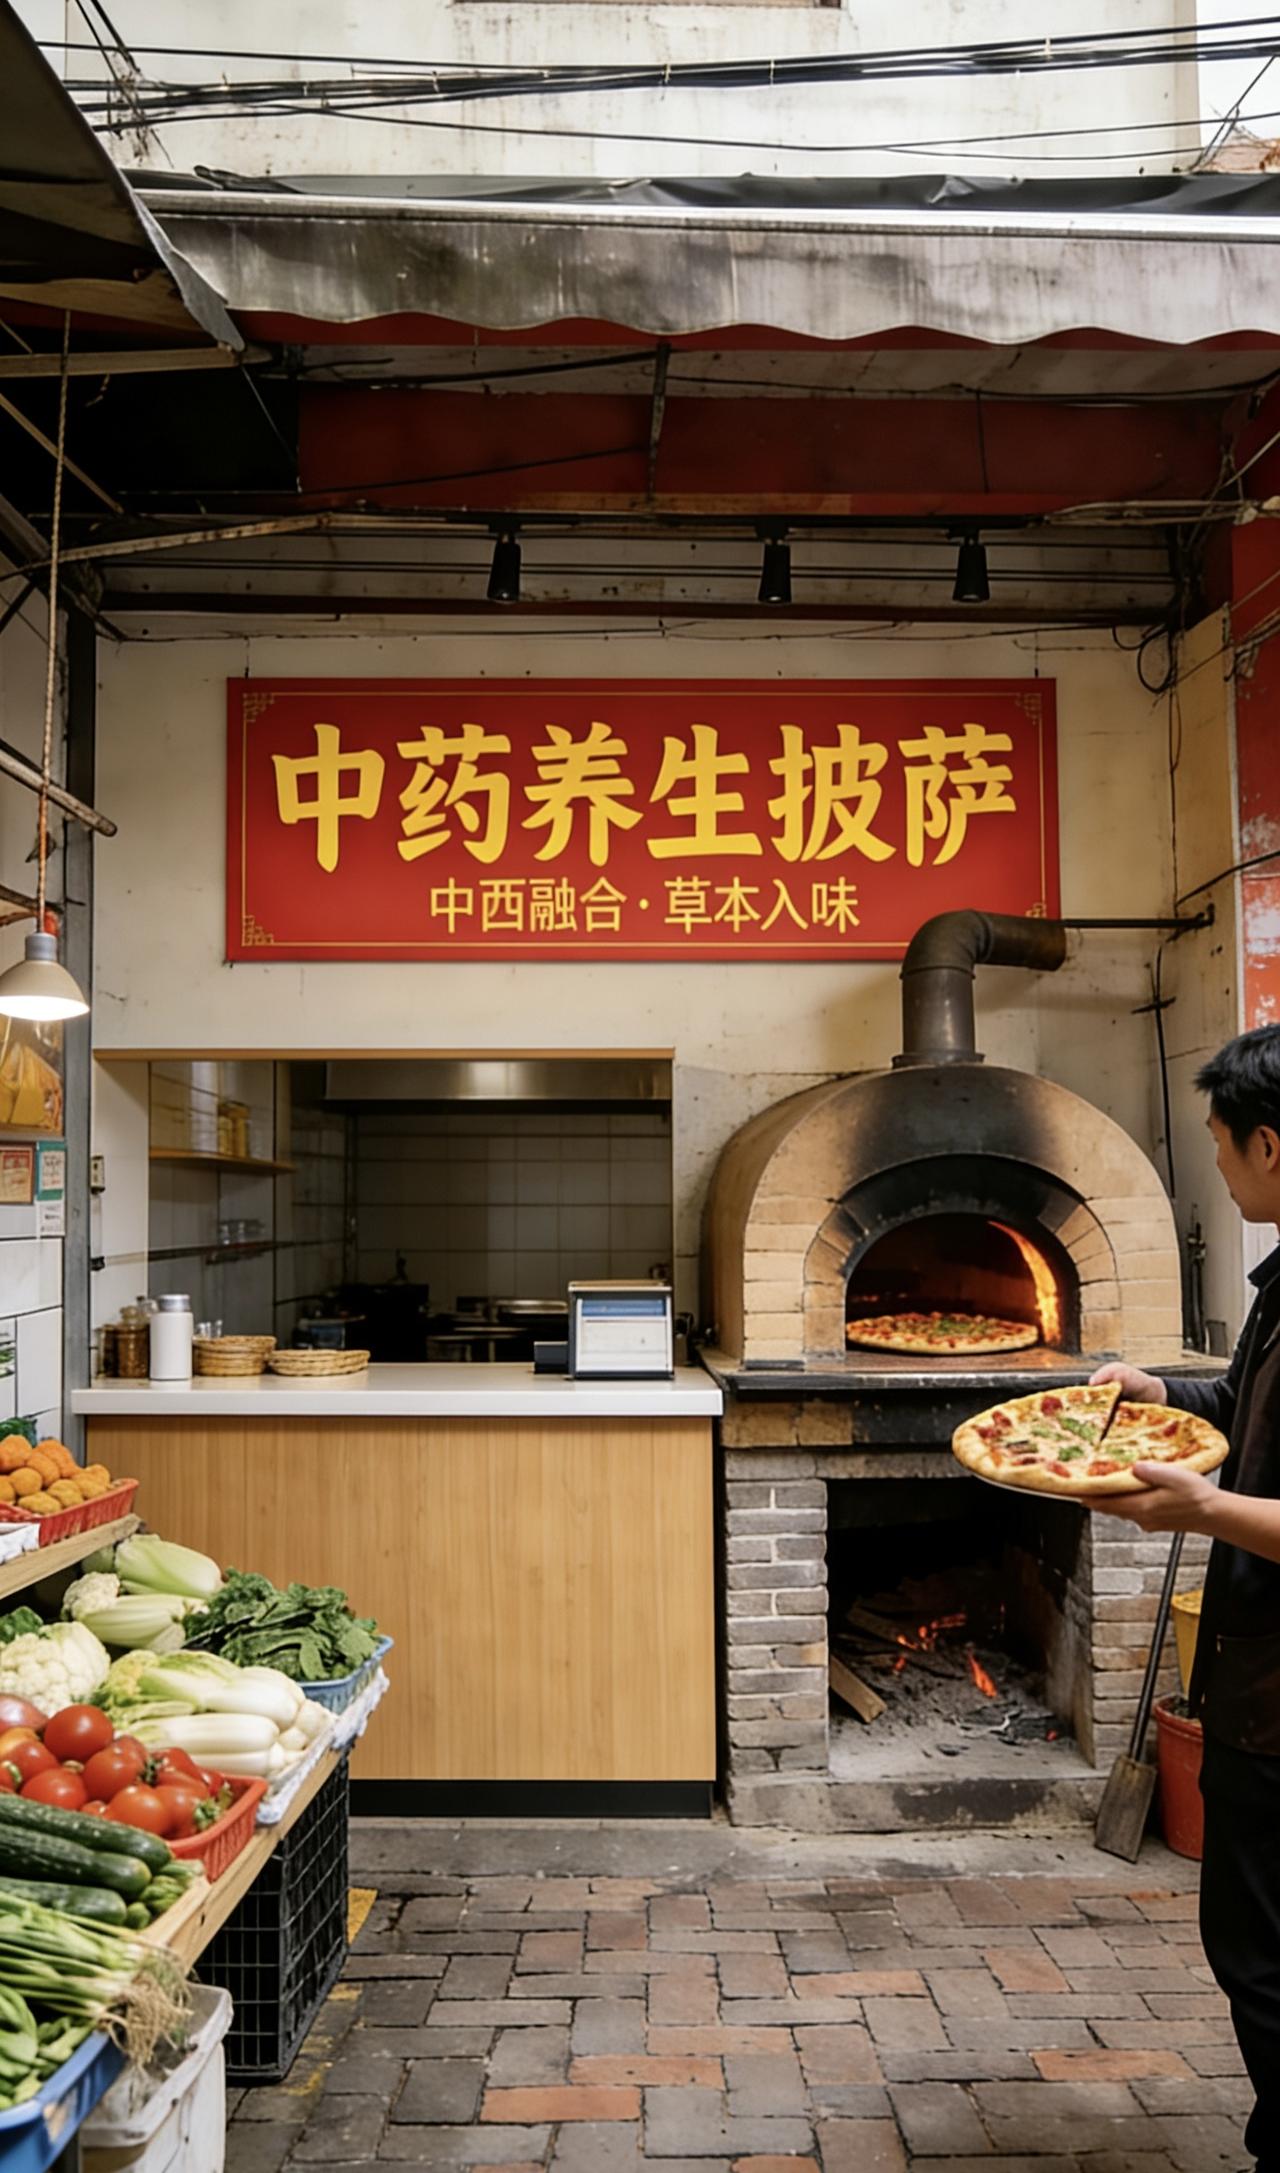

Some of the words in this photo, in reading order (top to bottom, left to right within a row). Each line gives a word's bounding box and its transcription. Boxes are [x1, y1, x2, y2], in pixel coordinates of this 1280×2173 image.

[271, 721, 1017, 874] 中药养生披萨
[429, 876, 861, 934] 中西融合·草本入味
